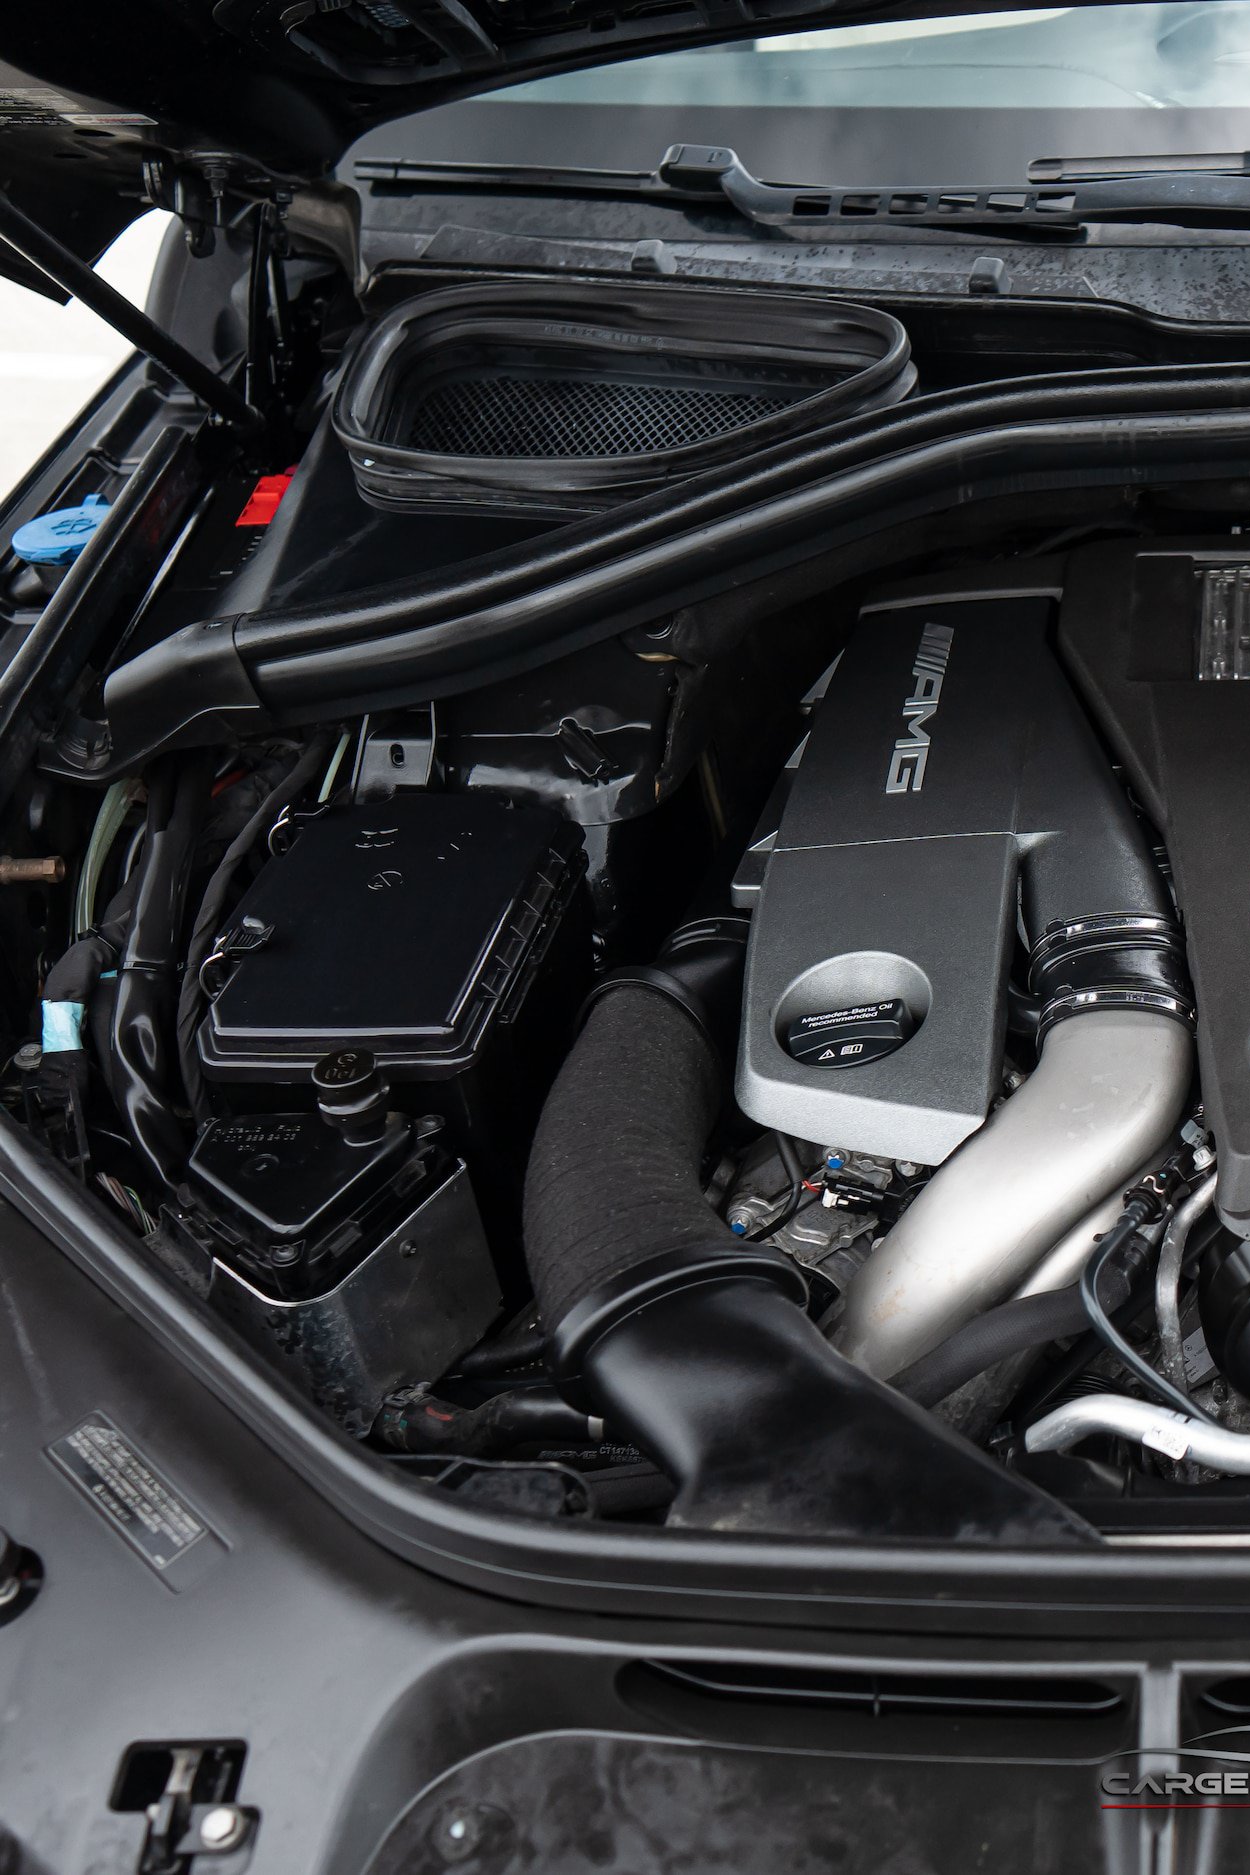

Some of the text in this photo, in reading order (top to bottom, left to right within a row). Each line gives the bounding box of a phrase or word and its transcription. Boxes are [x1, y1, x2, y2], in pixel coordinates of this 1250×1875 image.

[886, 666, 945, 794] AMG
[801, 1002, 893, 1024] Mercedes-Benz Oil
[808, 1011, 878, 1028] recommended
